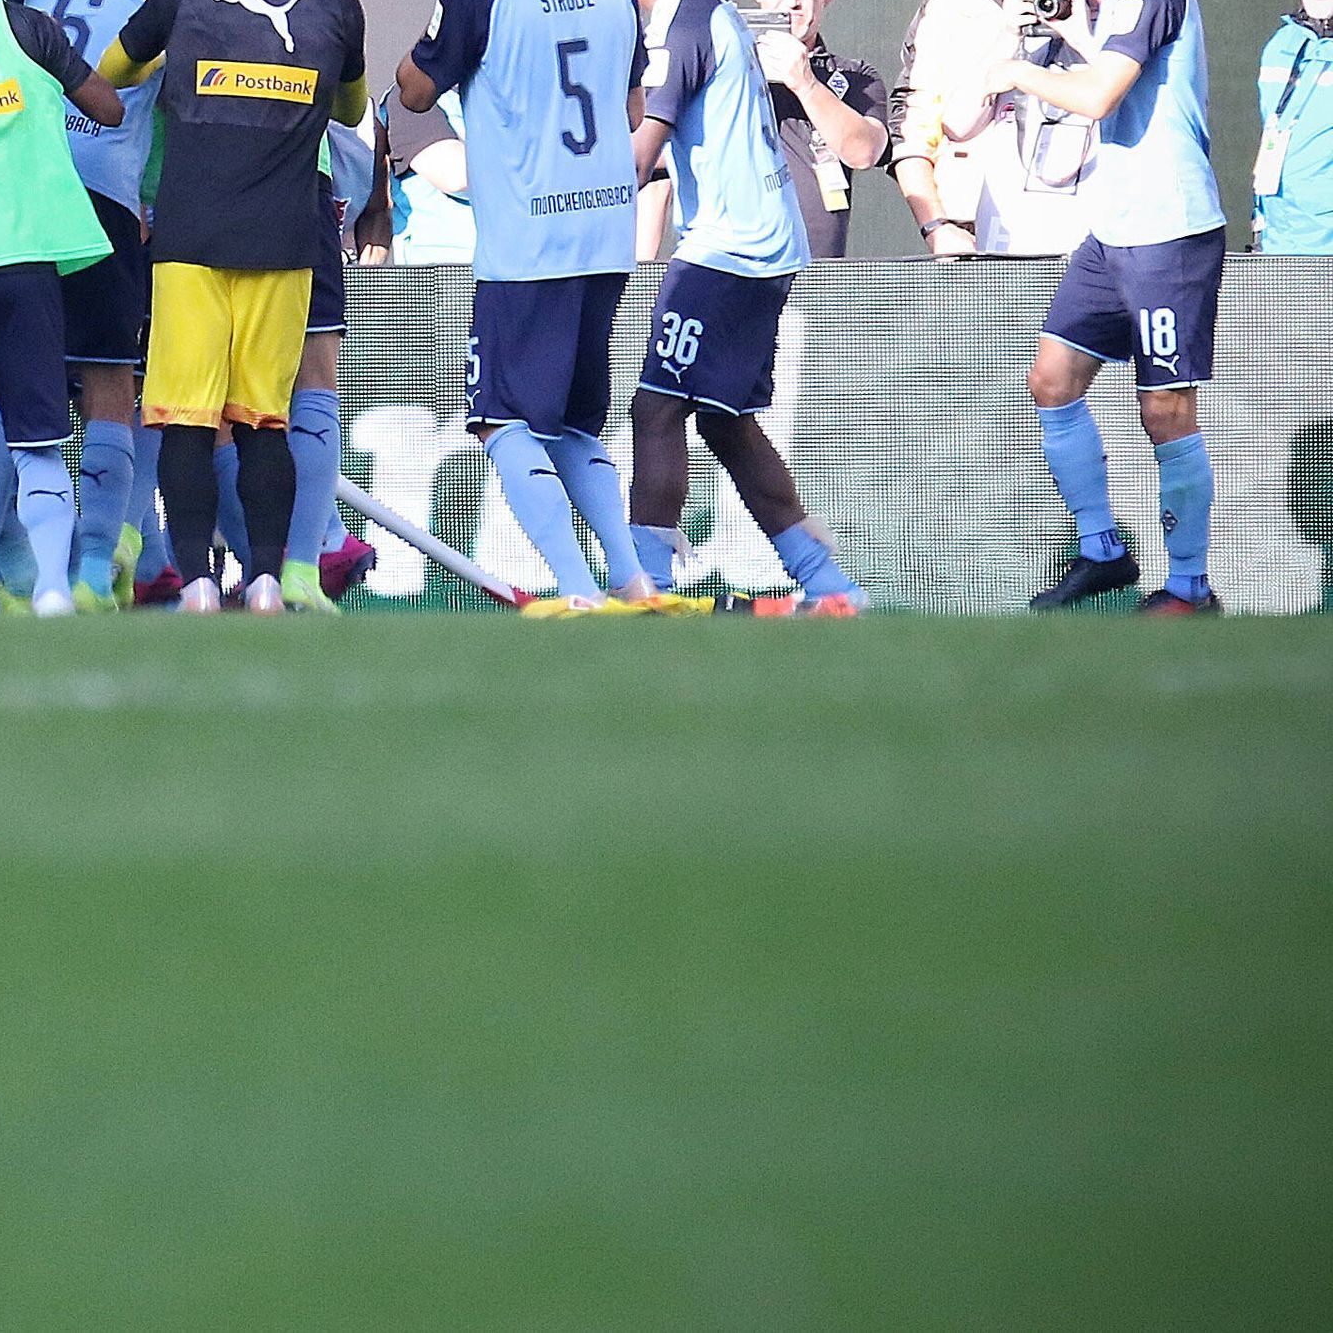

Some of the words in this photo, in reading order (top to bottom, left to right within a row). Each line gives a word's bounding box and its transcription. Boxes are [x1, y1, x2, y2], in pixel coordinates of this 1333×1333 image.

[236, 73, 311, 96] Postbank
[556, 39, 597, 155] 5
[655, 311, 704, 366] 36
[1140, 307, 1178, 357] 18
[466, 336, 482, 386] 5
